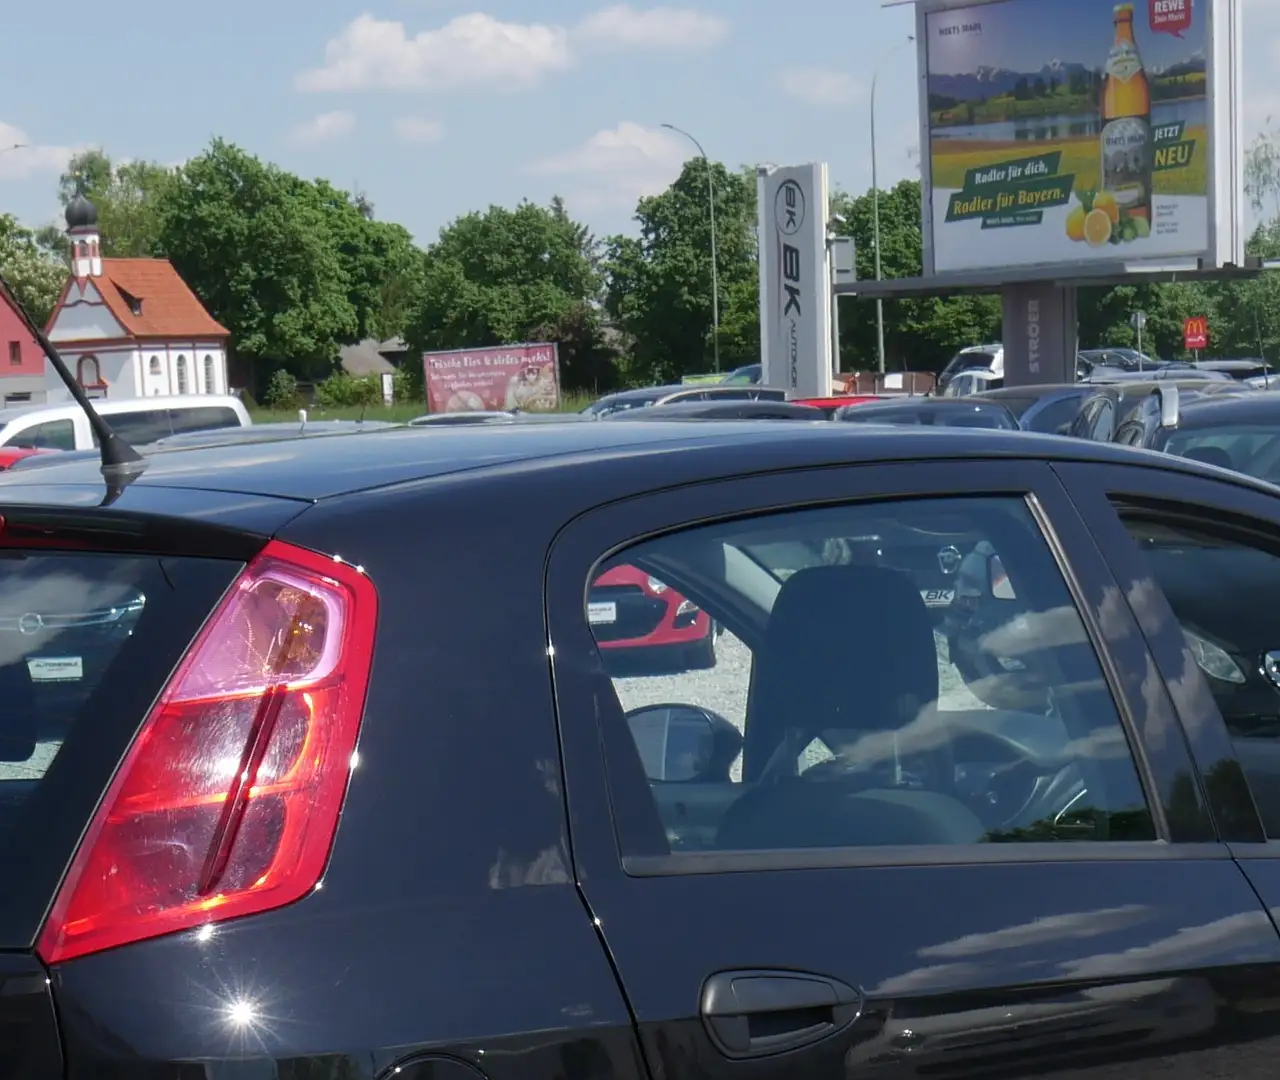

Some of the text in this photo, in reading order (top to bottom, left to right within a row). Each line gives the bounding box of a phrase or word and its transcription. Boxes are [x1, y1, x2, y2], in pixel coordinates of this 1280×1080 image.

[1154, 0, 1185, 13] REWE
[1154, 125, 1180, 142] JETZT
[1155, 145, 1189, 167] NEU
[975, 160, 1048, 185] Radler für dich,
[784, 185, 797, 229] BK
[953, 187, 1065, 215] Radler für Bayern.
[783, 242, 802, 317] BK
